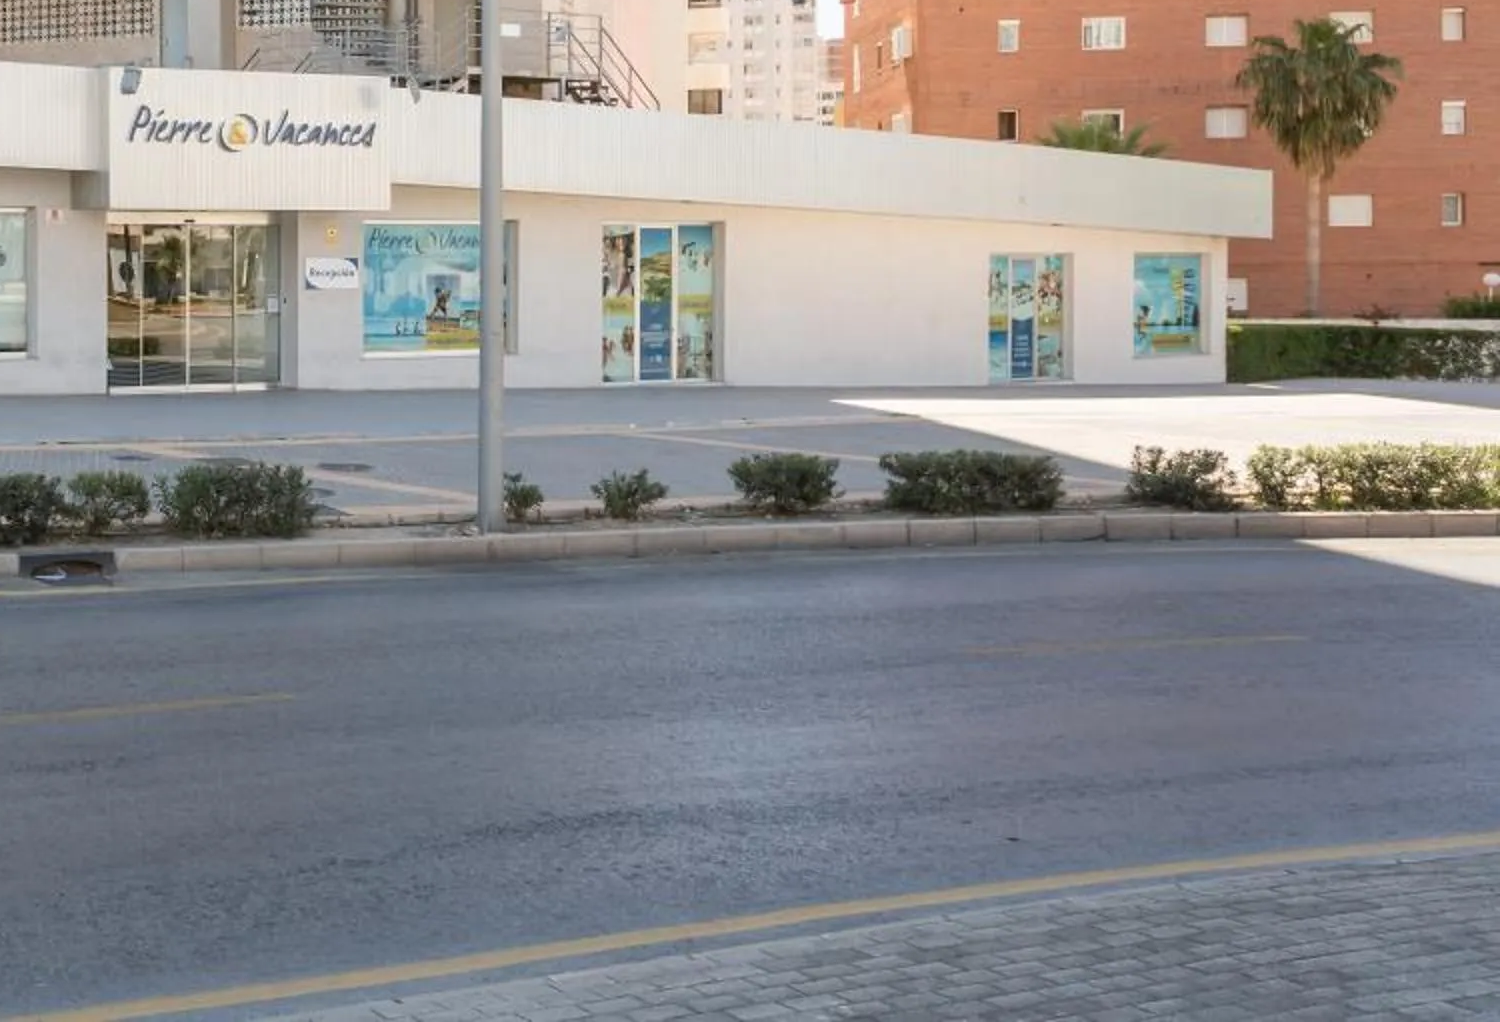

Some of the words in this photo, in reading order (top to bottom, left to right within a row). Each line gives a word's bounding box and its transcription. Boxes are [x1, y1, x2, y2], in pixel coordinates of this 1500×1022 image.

[128, 104, 213, 144] Pierre
[264, 109, 377, 148] Vacances
[438, 229, 480, 251] Vacan
